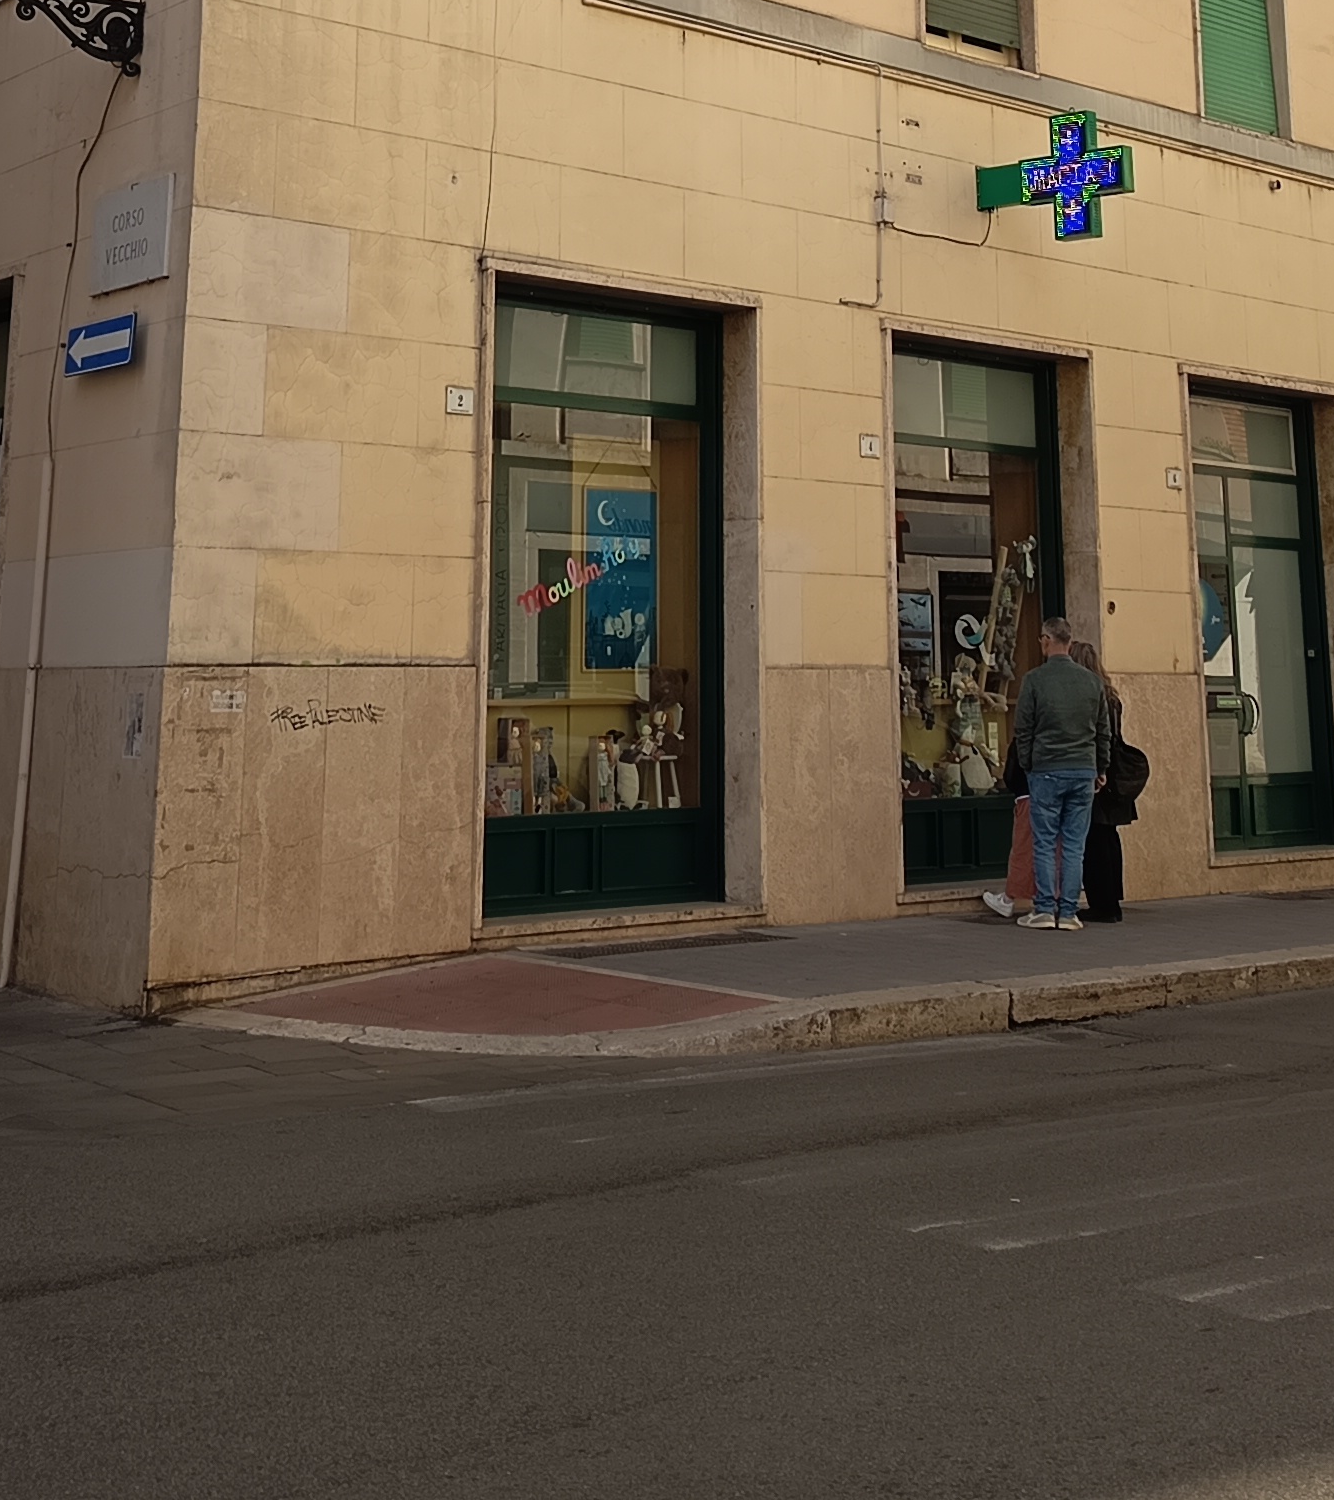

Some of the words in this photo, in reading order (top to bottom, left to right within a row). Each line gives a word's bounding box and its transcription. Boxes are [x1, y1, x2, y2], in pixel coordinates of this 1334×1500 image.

[112, 207, 145, 233] CORSO
[105, 237, 148, 265] VECCHIO
[457, 394, 464, 407] 2
[517, 557, 603, 618] Moulin
